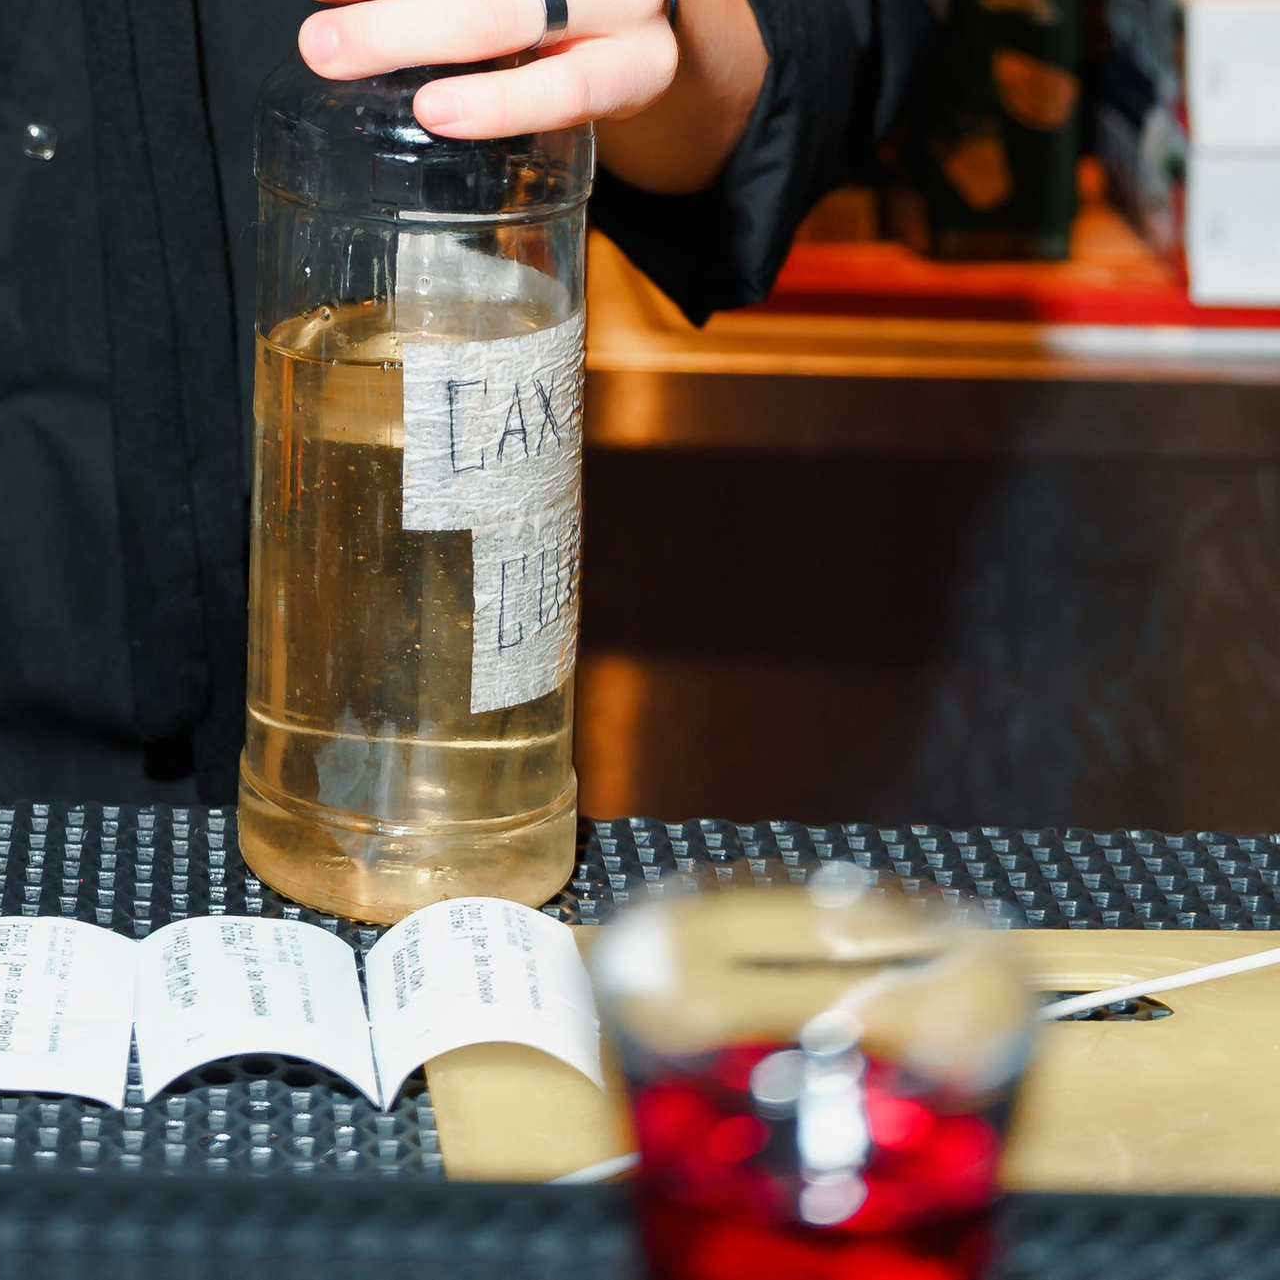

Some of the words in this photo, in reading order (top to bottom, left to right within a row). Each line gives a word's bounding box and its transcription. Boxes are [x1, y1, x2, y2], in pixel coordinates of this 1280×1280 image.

[449, 903, 467, 932] Гостей:
[467, 903, 484, 922] Стол:
[13, 923, 33, 946] Стол:
[220, 922, 239, 948] Гостей:
[238, 923, 255, 943] Стол:
[247, 969, 265, 981] Зал
[474, 954, 492, 967] Зал
[7, 962, 27, 981] Зал:
[4, 987, 23, 1005] Зал
[476, 970, 498, 1004] Основной
